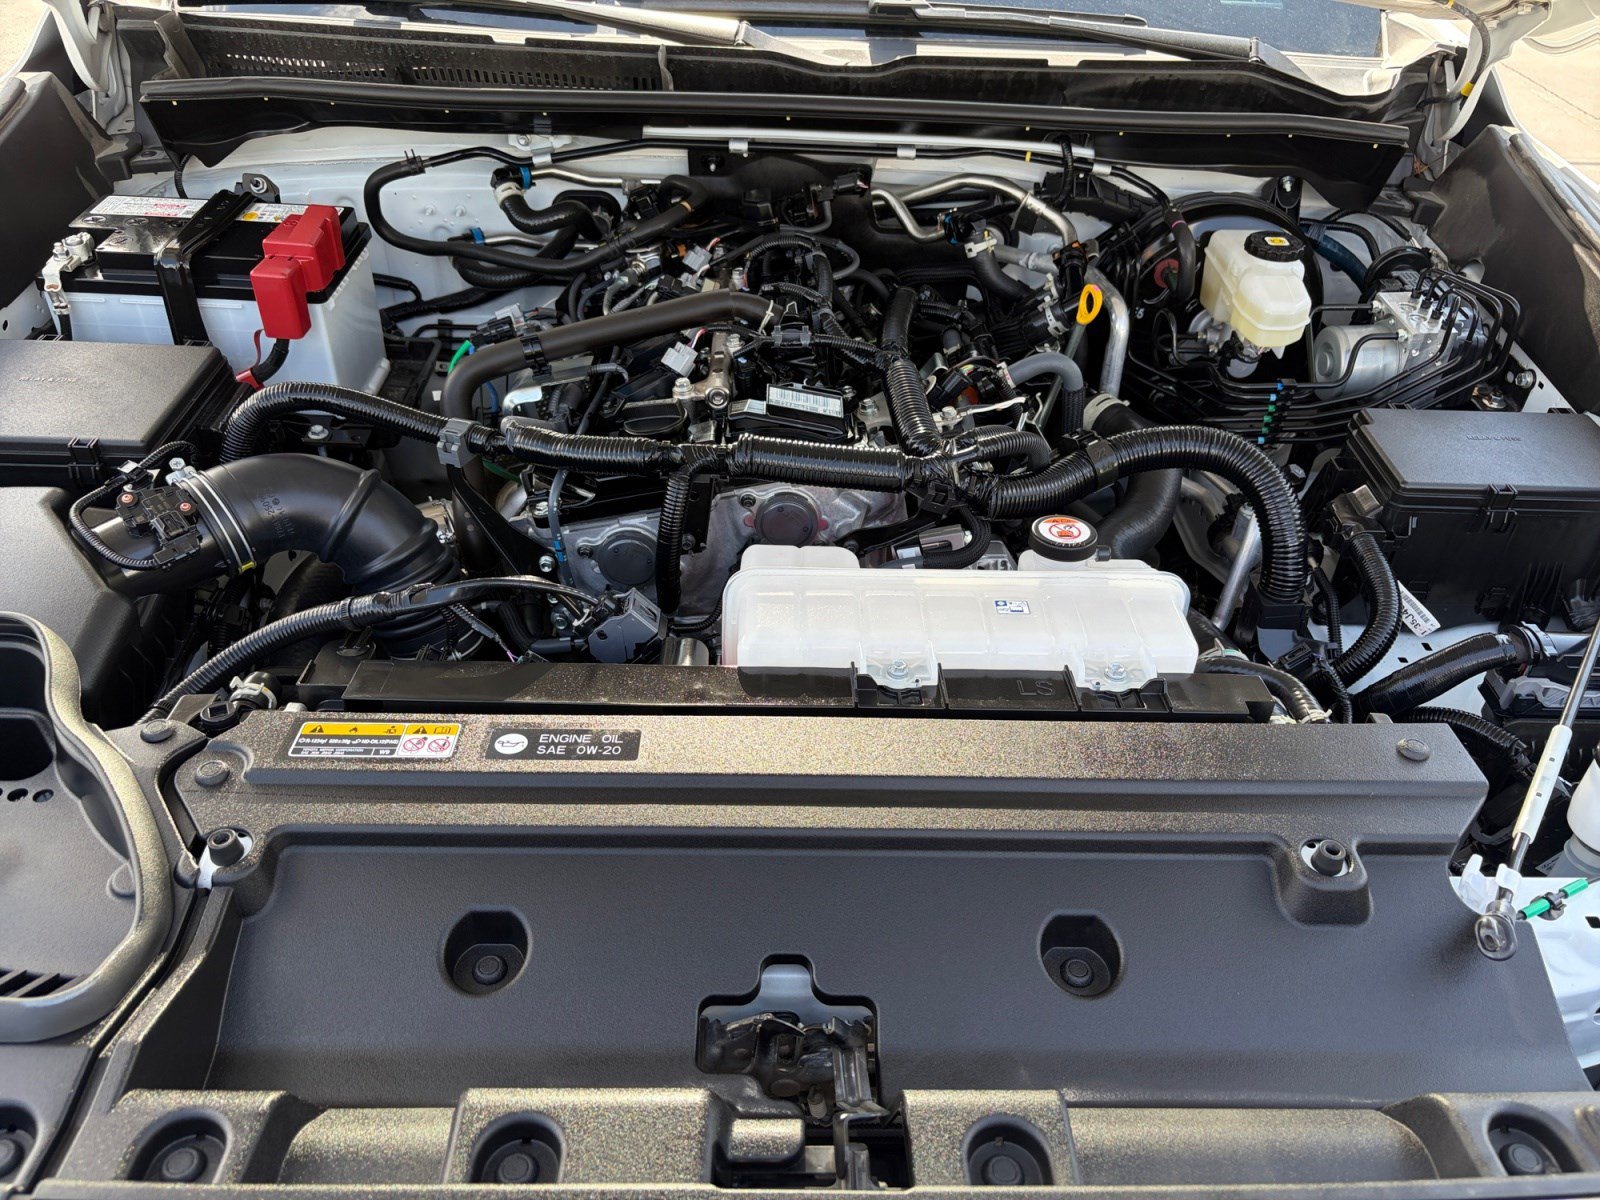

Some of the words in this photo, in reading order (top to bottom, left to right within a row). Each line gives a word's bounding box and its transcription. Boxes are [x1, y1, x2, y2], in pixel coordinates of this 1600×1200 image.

[1016, 679, 1055, 696] LS
[539, 733, 592, 744] ENGINE
[601, 734, 624, 744] OIL
[536, 745, 567, 755] SAE
[576, 745, 622, 755] 0W-20
